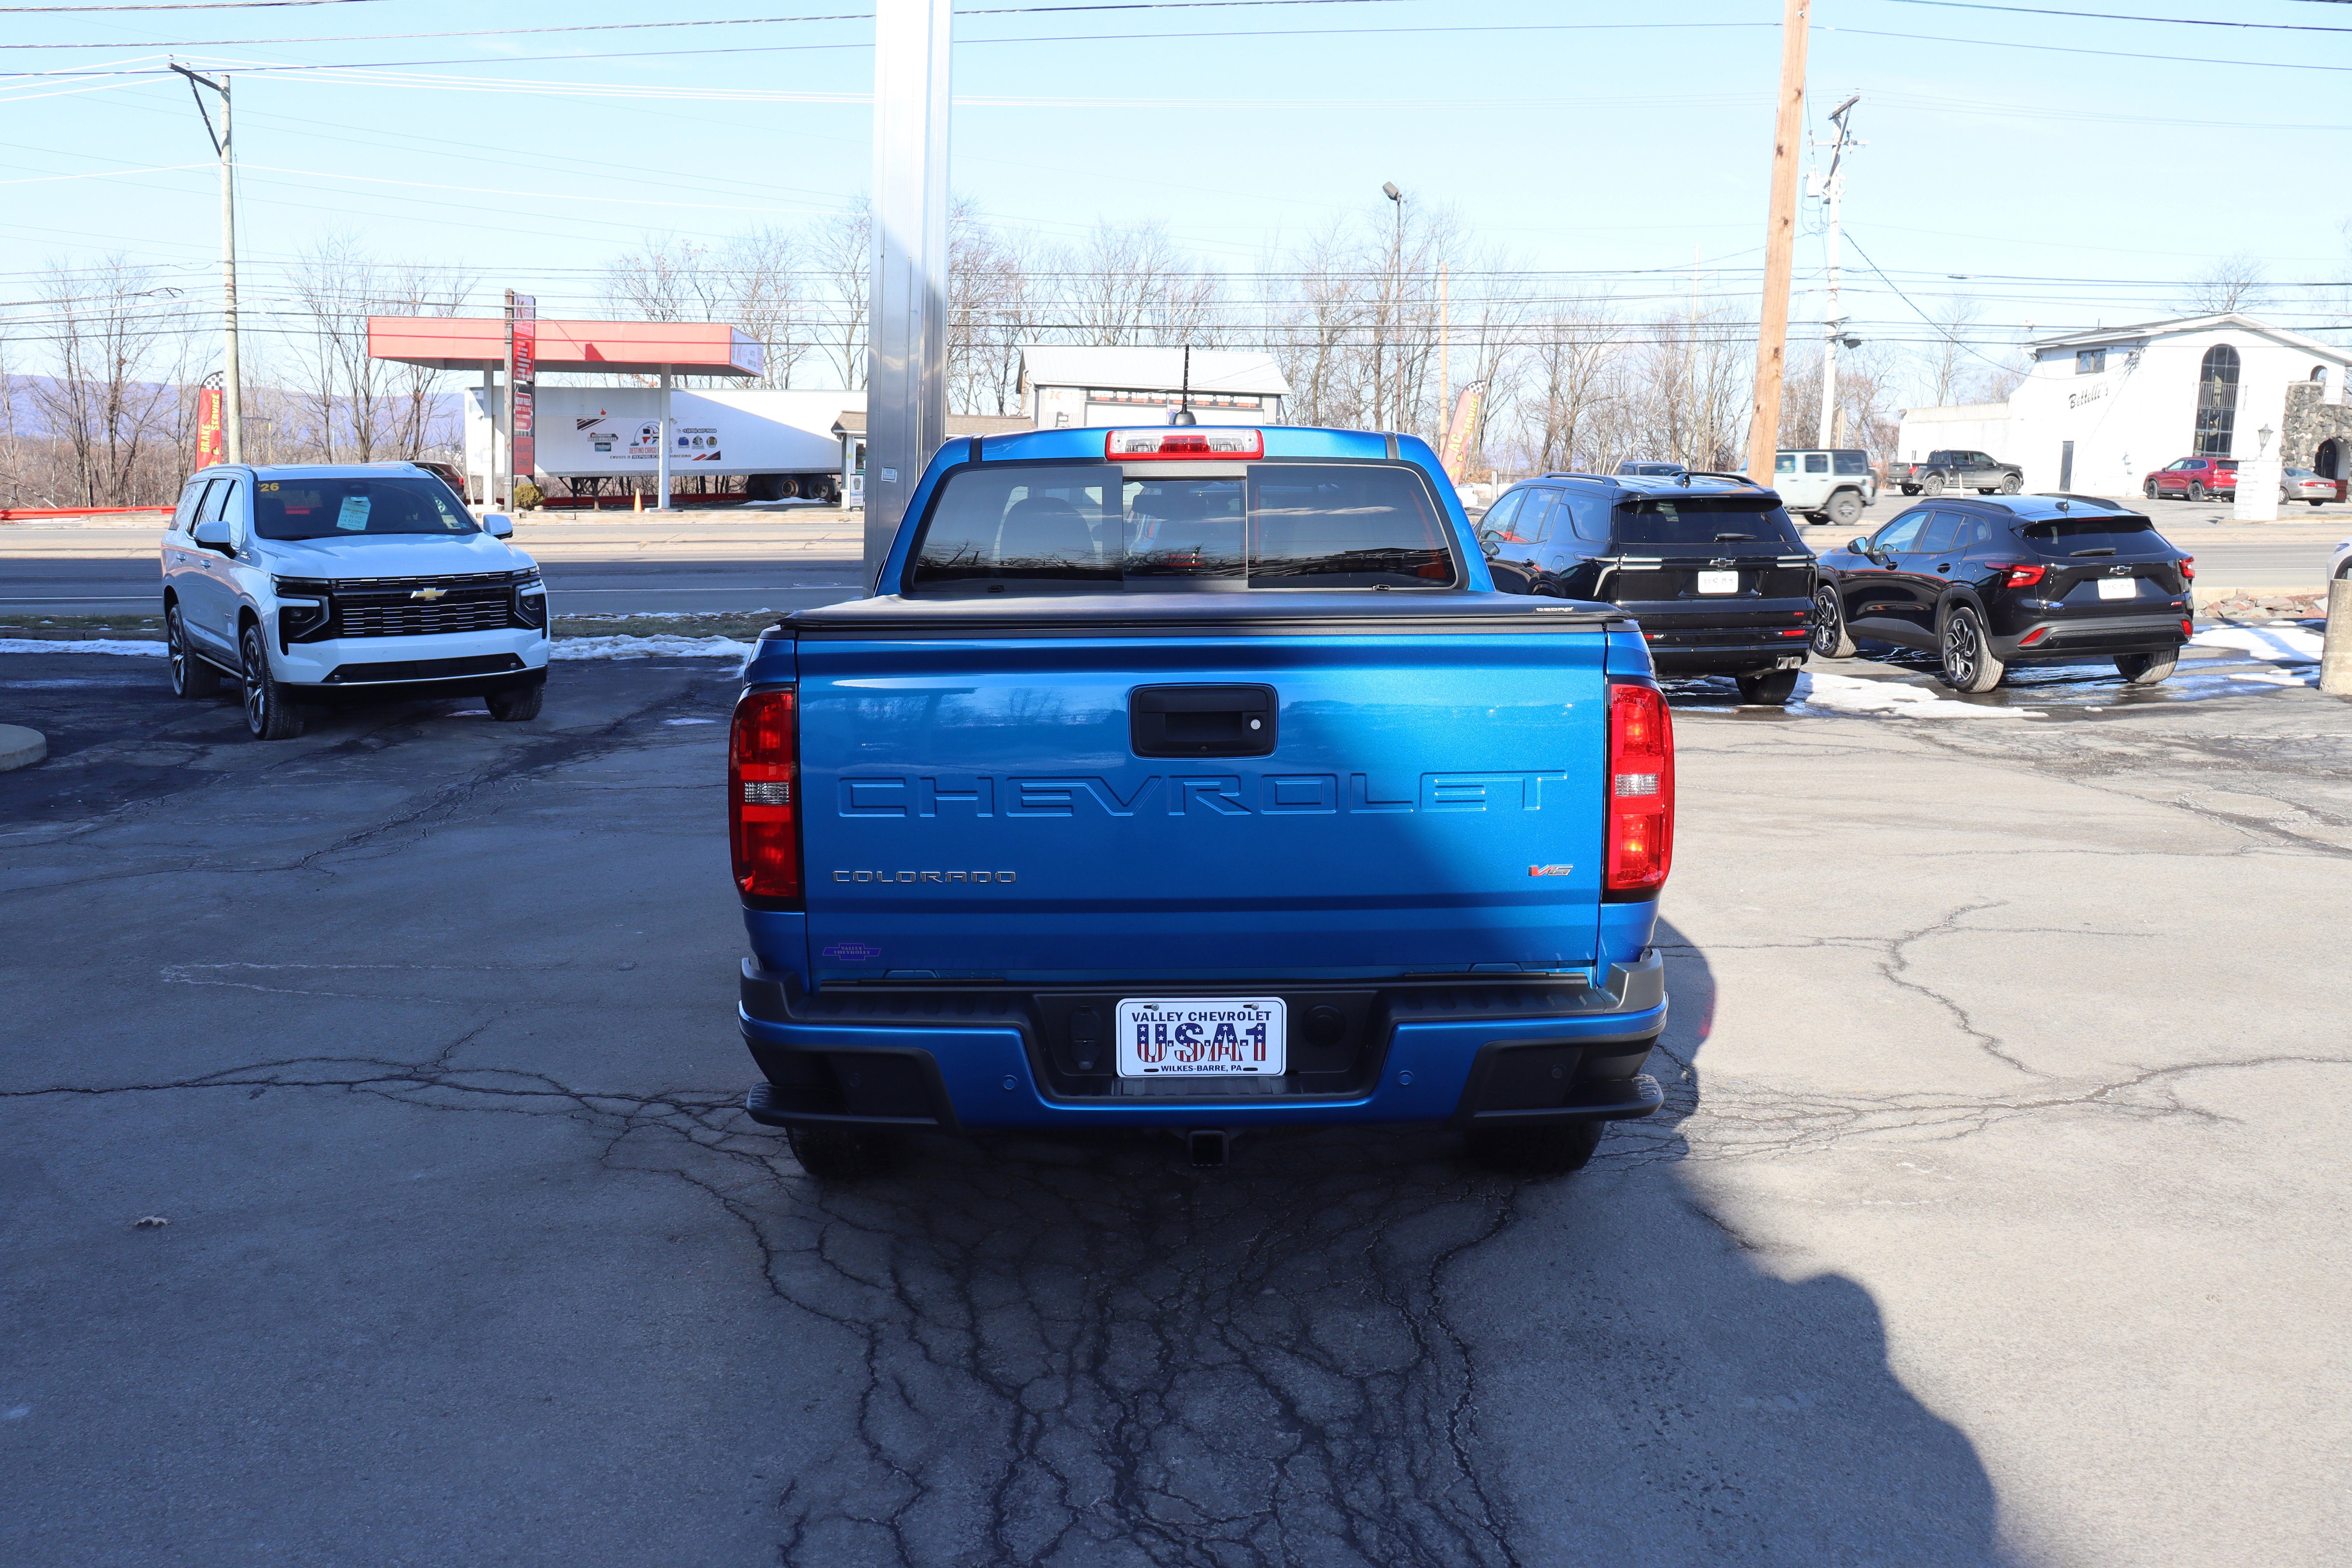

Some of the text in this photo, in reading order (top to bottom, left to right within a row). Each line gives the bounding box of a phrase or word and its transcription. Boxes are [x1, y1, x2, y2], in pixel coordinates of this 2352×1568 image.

[210, 393, 220, 431] SERVICE
[1462, 395, 1478, 435] SERVICE
[200, 423, 211, 453] BRAKE
[1447, 433, 1464, 453] AC
[837, 770, 1567, 817] CHEVROLET
[832, 871, 1016, 883] COLORADO
[1528, 864, 1574, 877] V6
[1131, 1011, 1272, 1022] VALLEY CHEVROLET
